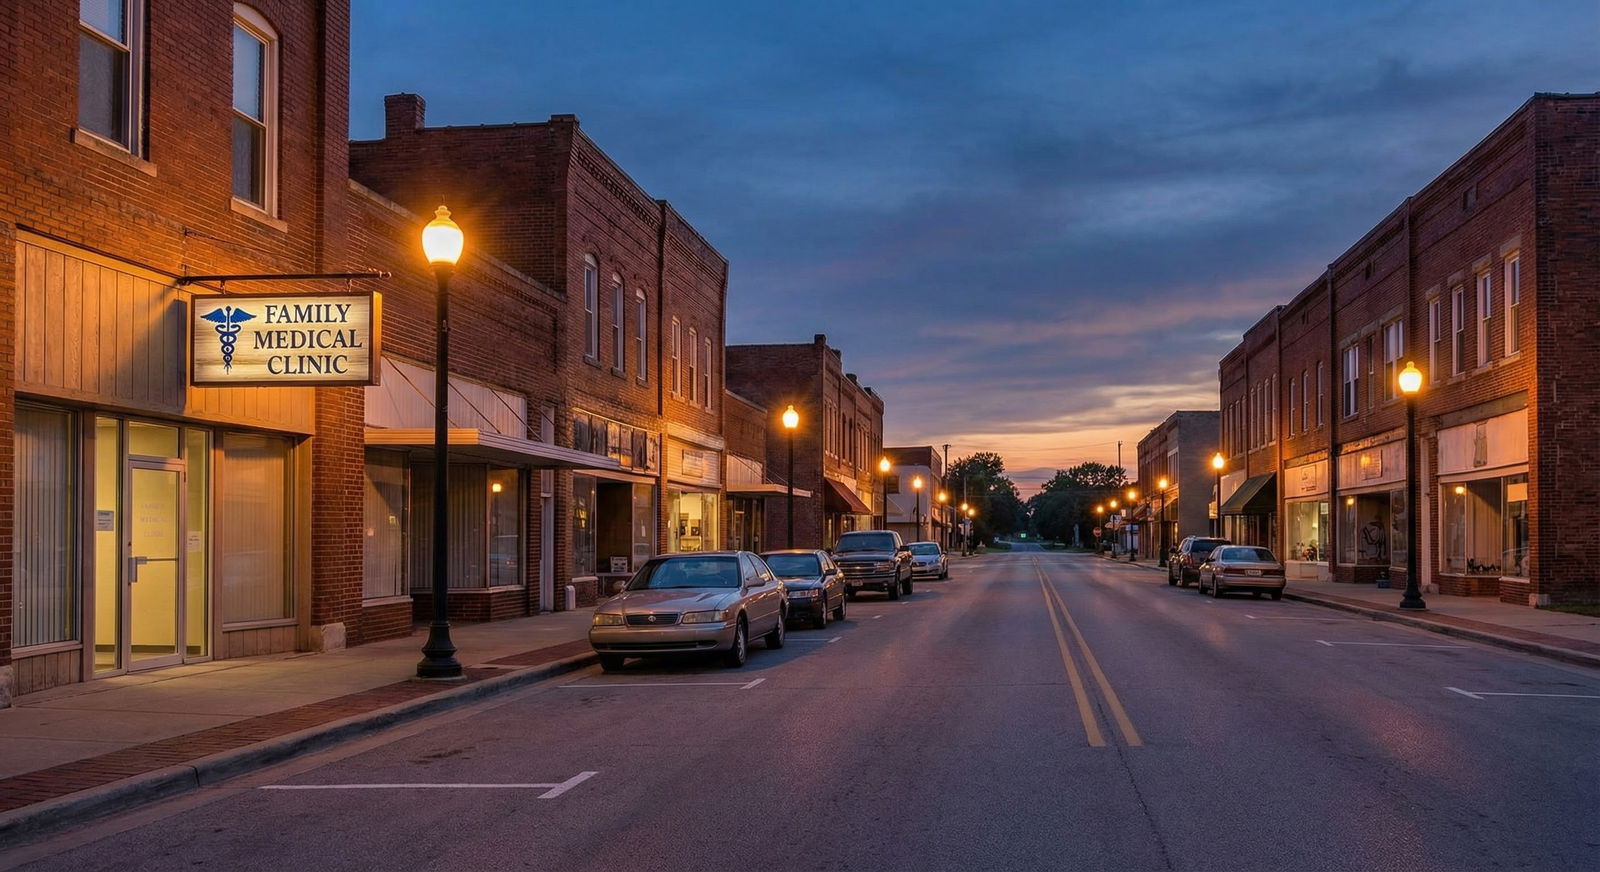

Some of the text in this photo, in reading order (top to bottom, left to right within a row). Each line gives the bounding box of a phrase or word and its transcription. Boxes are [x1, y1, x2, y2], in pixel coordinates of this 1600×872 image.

[265, 304, 352, 324] FAMILY
[253, 329, 363, 349] MEDICAL
[267, 354, 348, 374] CLINIC
